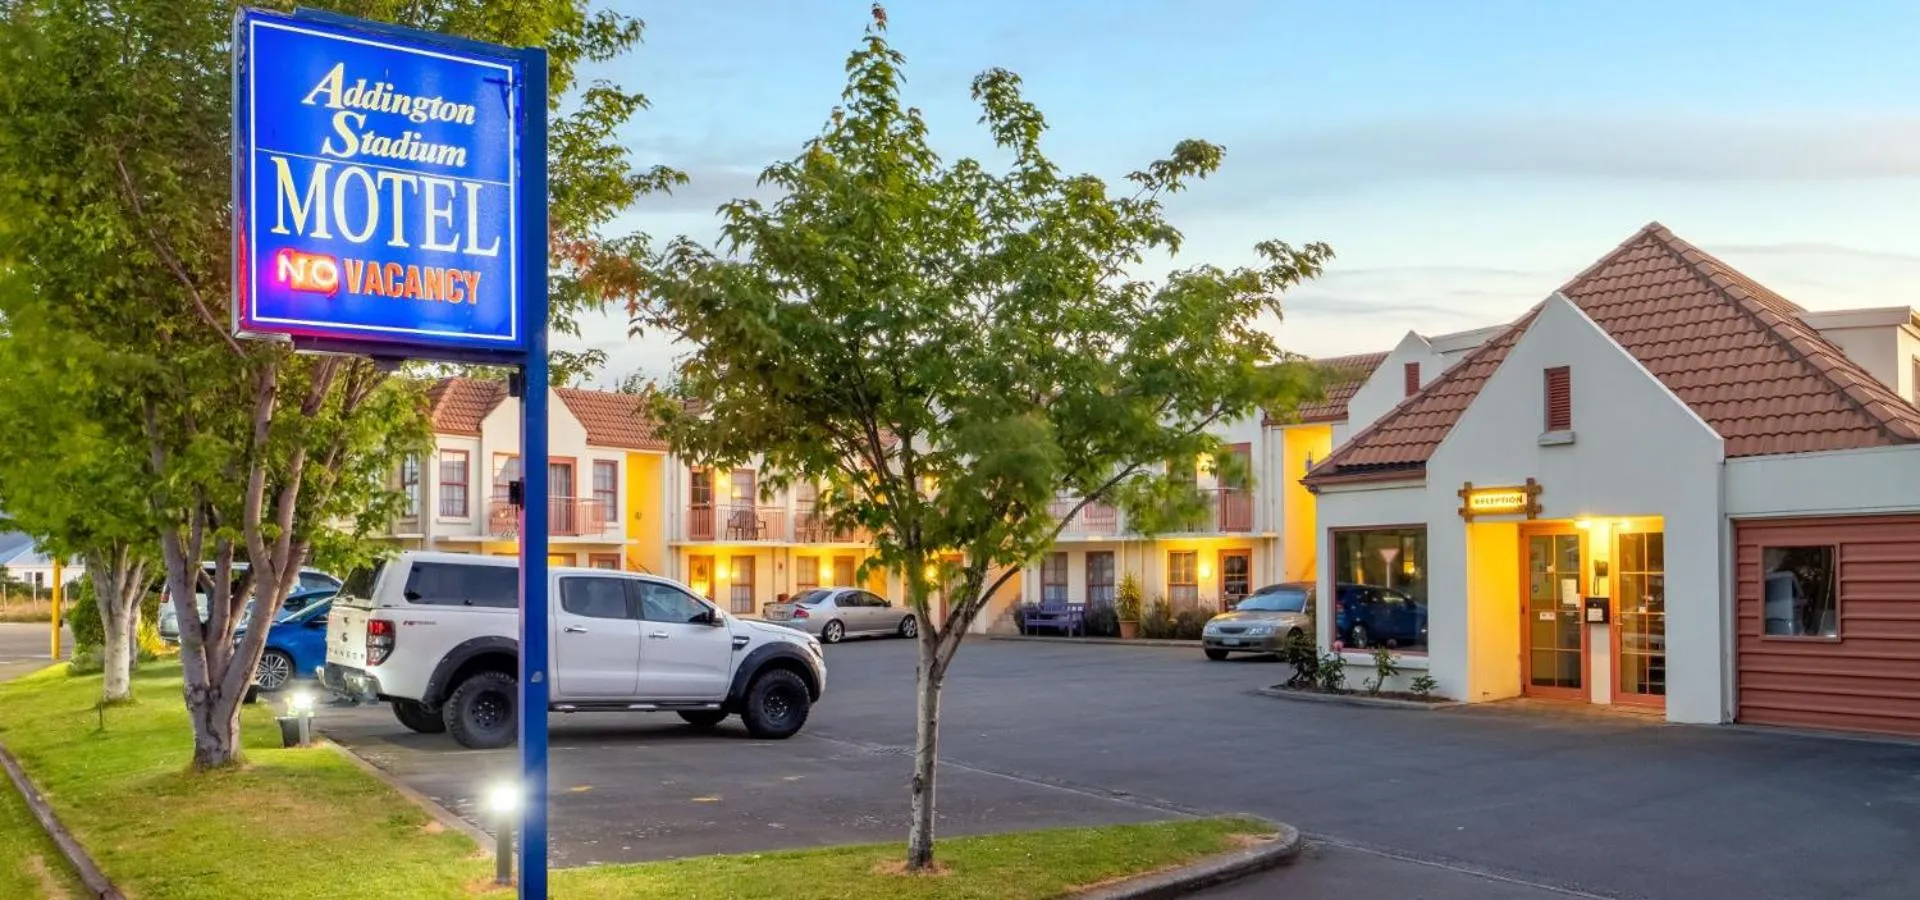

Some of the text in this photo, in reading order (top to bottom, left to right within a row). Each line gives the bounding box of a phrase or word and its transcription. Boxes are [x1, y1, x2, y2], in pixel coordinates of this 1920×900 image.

[301, 62, 476, 125] Addington
[322, 111, 467, 168] Stadium
[271, 156, 500, 257] MOTEL
[277, 252, 482, 305] NO VACANCY
